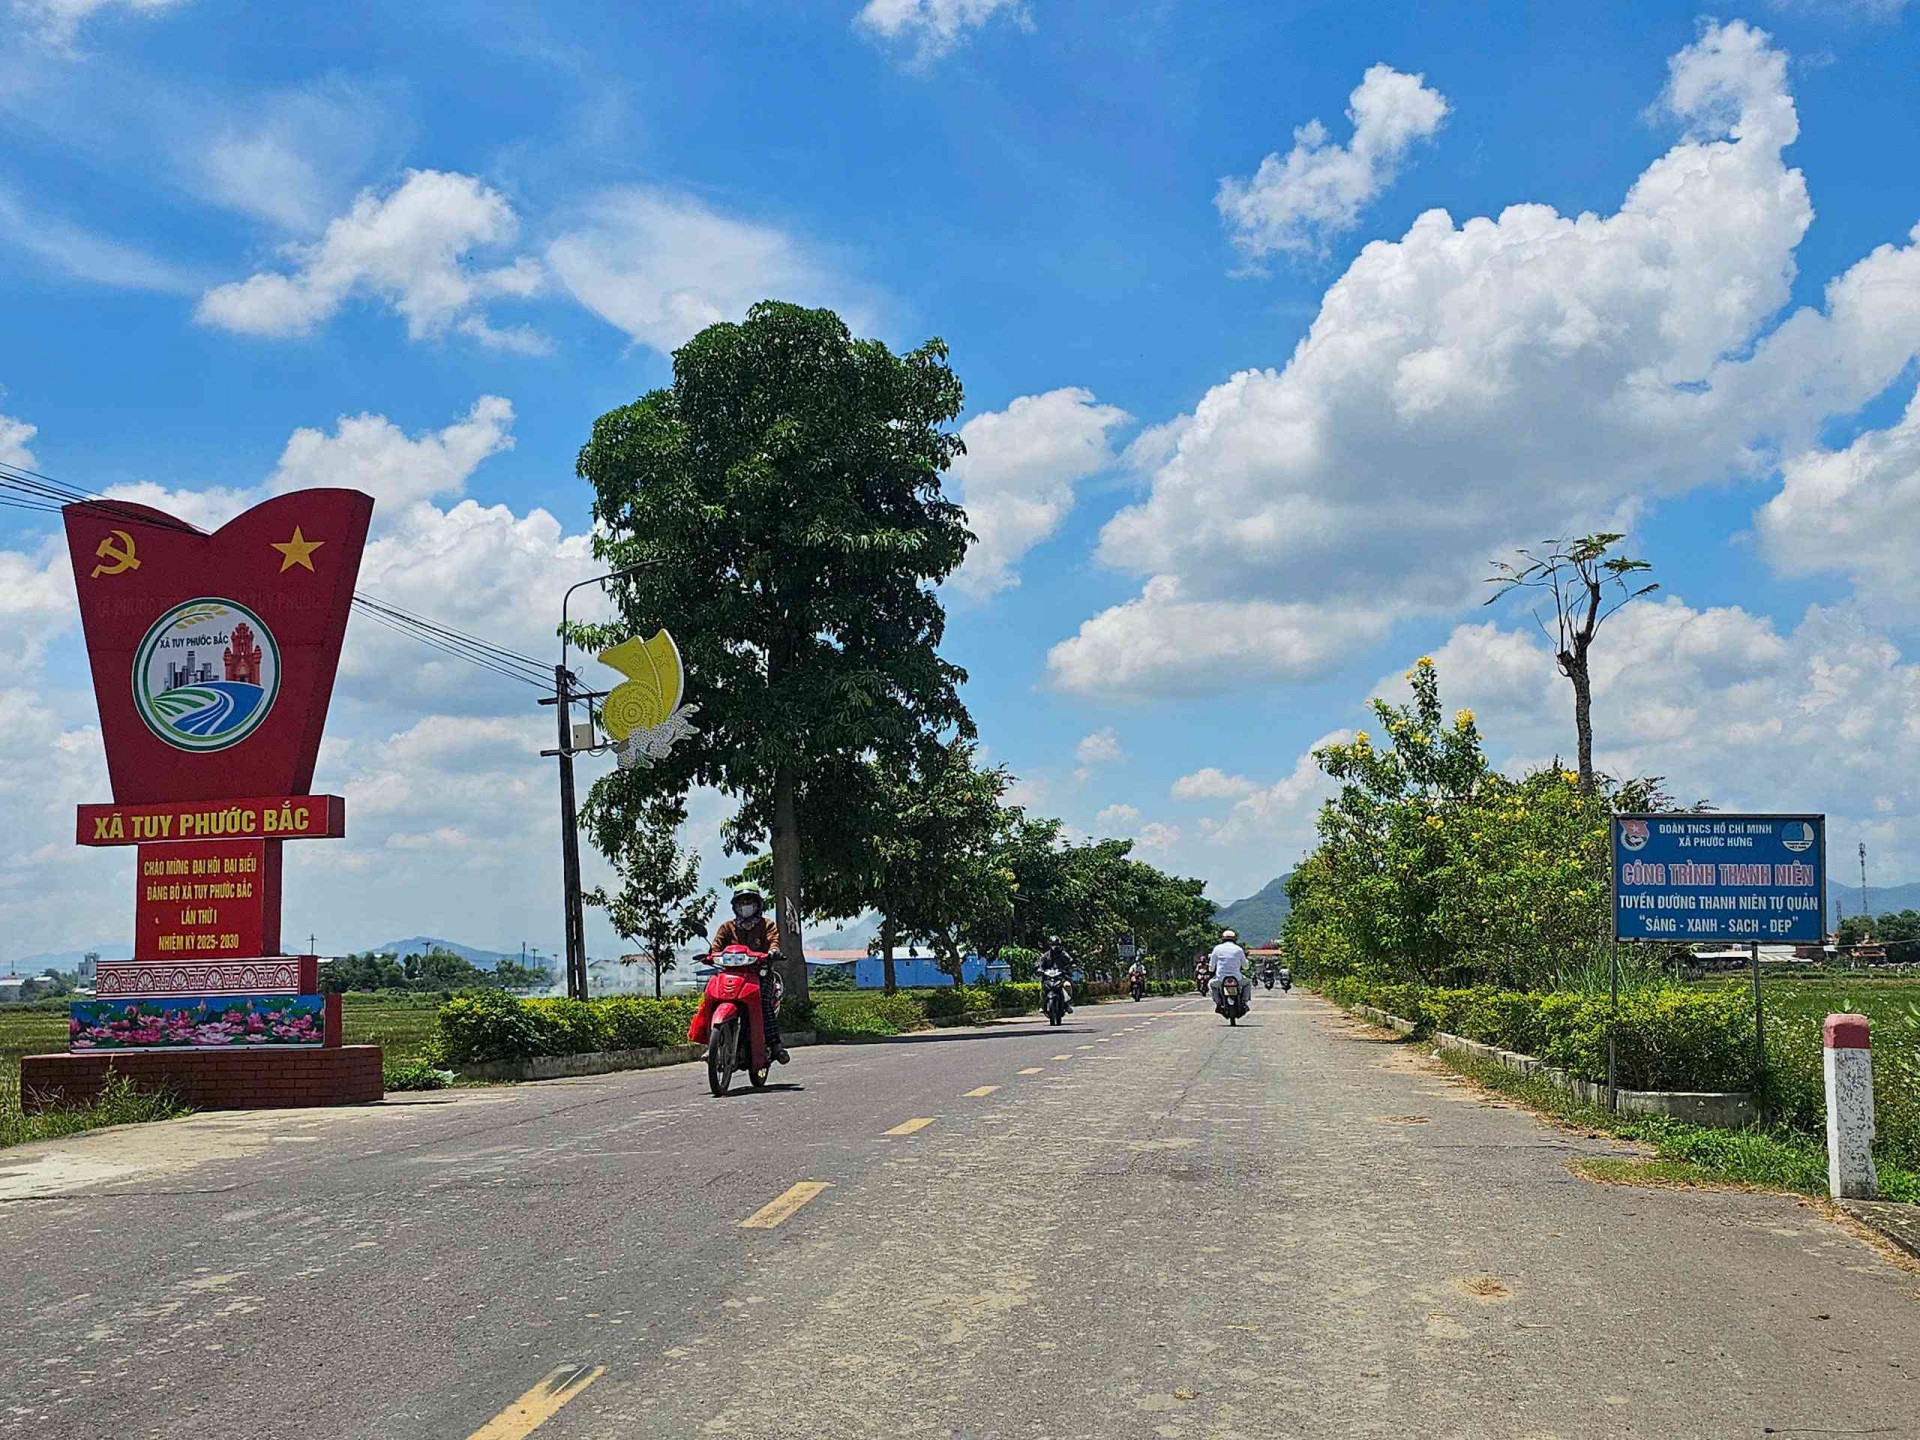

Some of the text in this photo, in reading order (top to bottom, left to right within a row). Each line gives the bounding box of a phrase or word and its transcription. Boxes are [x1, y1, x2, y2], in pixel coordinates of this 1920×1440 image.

[160, 631, 229, 648] XÃ TUY PHƯỚC BẮC
[94, 800, 309, 839] XÃ TUY PHƯỚC BẮC
[1659, 821, 1772, 834] ĐOÀN TNCS HỒ CHÍ MINH
[1679, 836, 1753, 847] XÃ PHƯỚC HƯNG
[166, 857, 189, 875] MỪNG
[192, 859, 205, 877] ĐẠI
[207, 855, 220, 877] HỘI
[224, 858, 237, 876] ĐẠI
[1622, 859, 1814, 887] CÔNG TRÌNH THANH NIÊN
[147, 880, 167, 901] ĐẢNG
[169, 882, 180, 903] BỘ
[182, 882, 192, 900] XÃ
[194, 884, 208, 900] TUY
[1619, 891, 1655, 909] TUYẾN
[1698, 896, 1736, 910] THANH
[1739, 893, 1767, 910] NIÊN
[1769, 895, 1785, 913] TỰ
[1787, 892, 1818, 911] QUẢN
[198, 906, 213, 924] THỨ
[214, 909, 218, 924] I
[1687, 918, 1718, 933] XANH
[1728, 918, 1759, 936] SẠCH
[159, 932, 184, 954] NHIỆM
[220, 934, 239, 949] 2030
